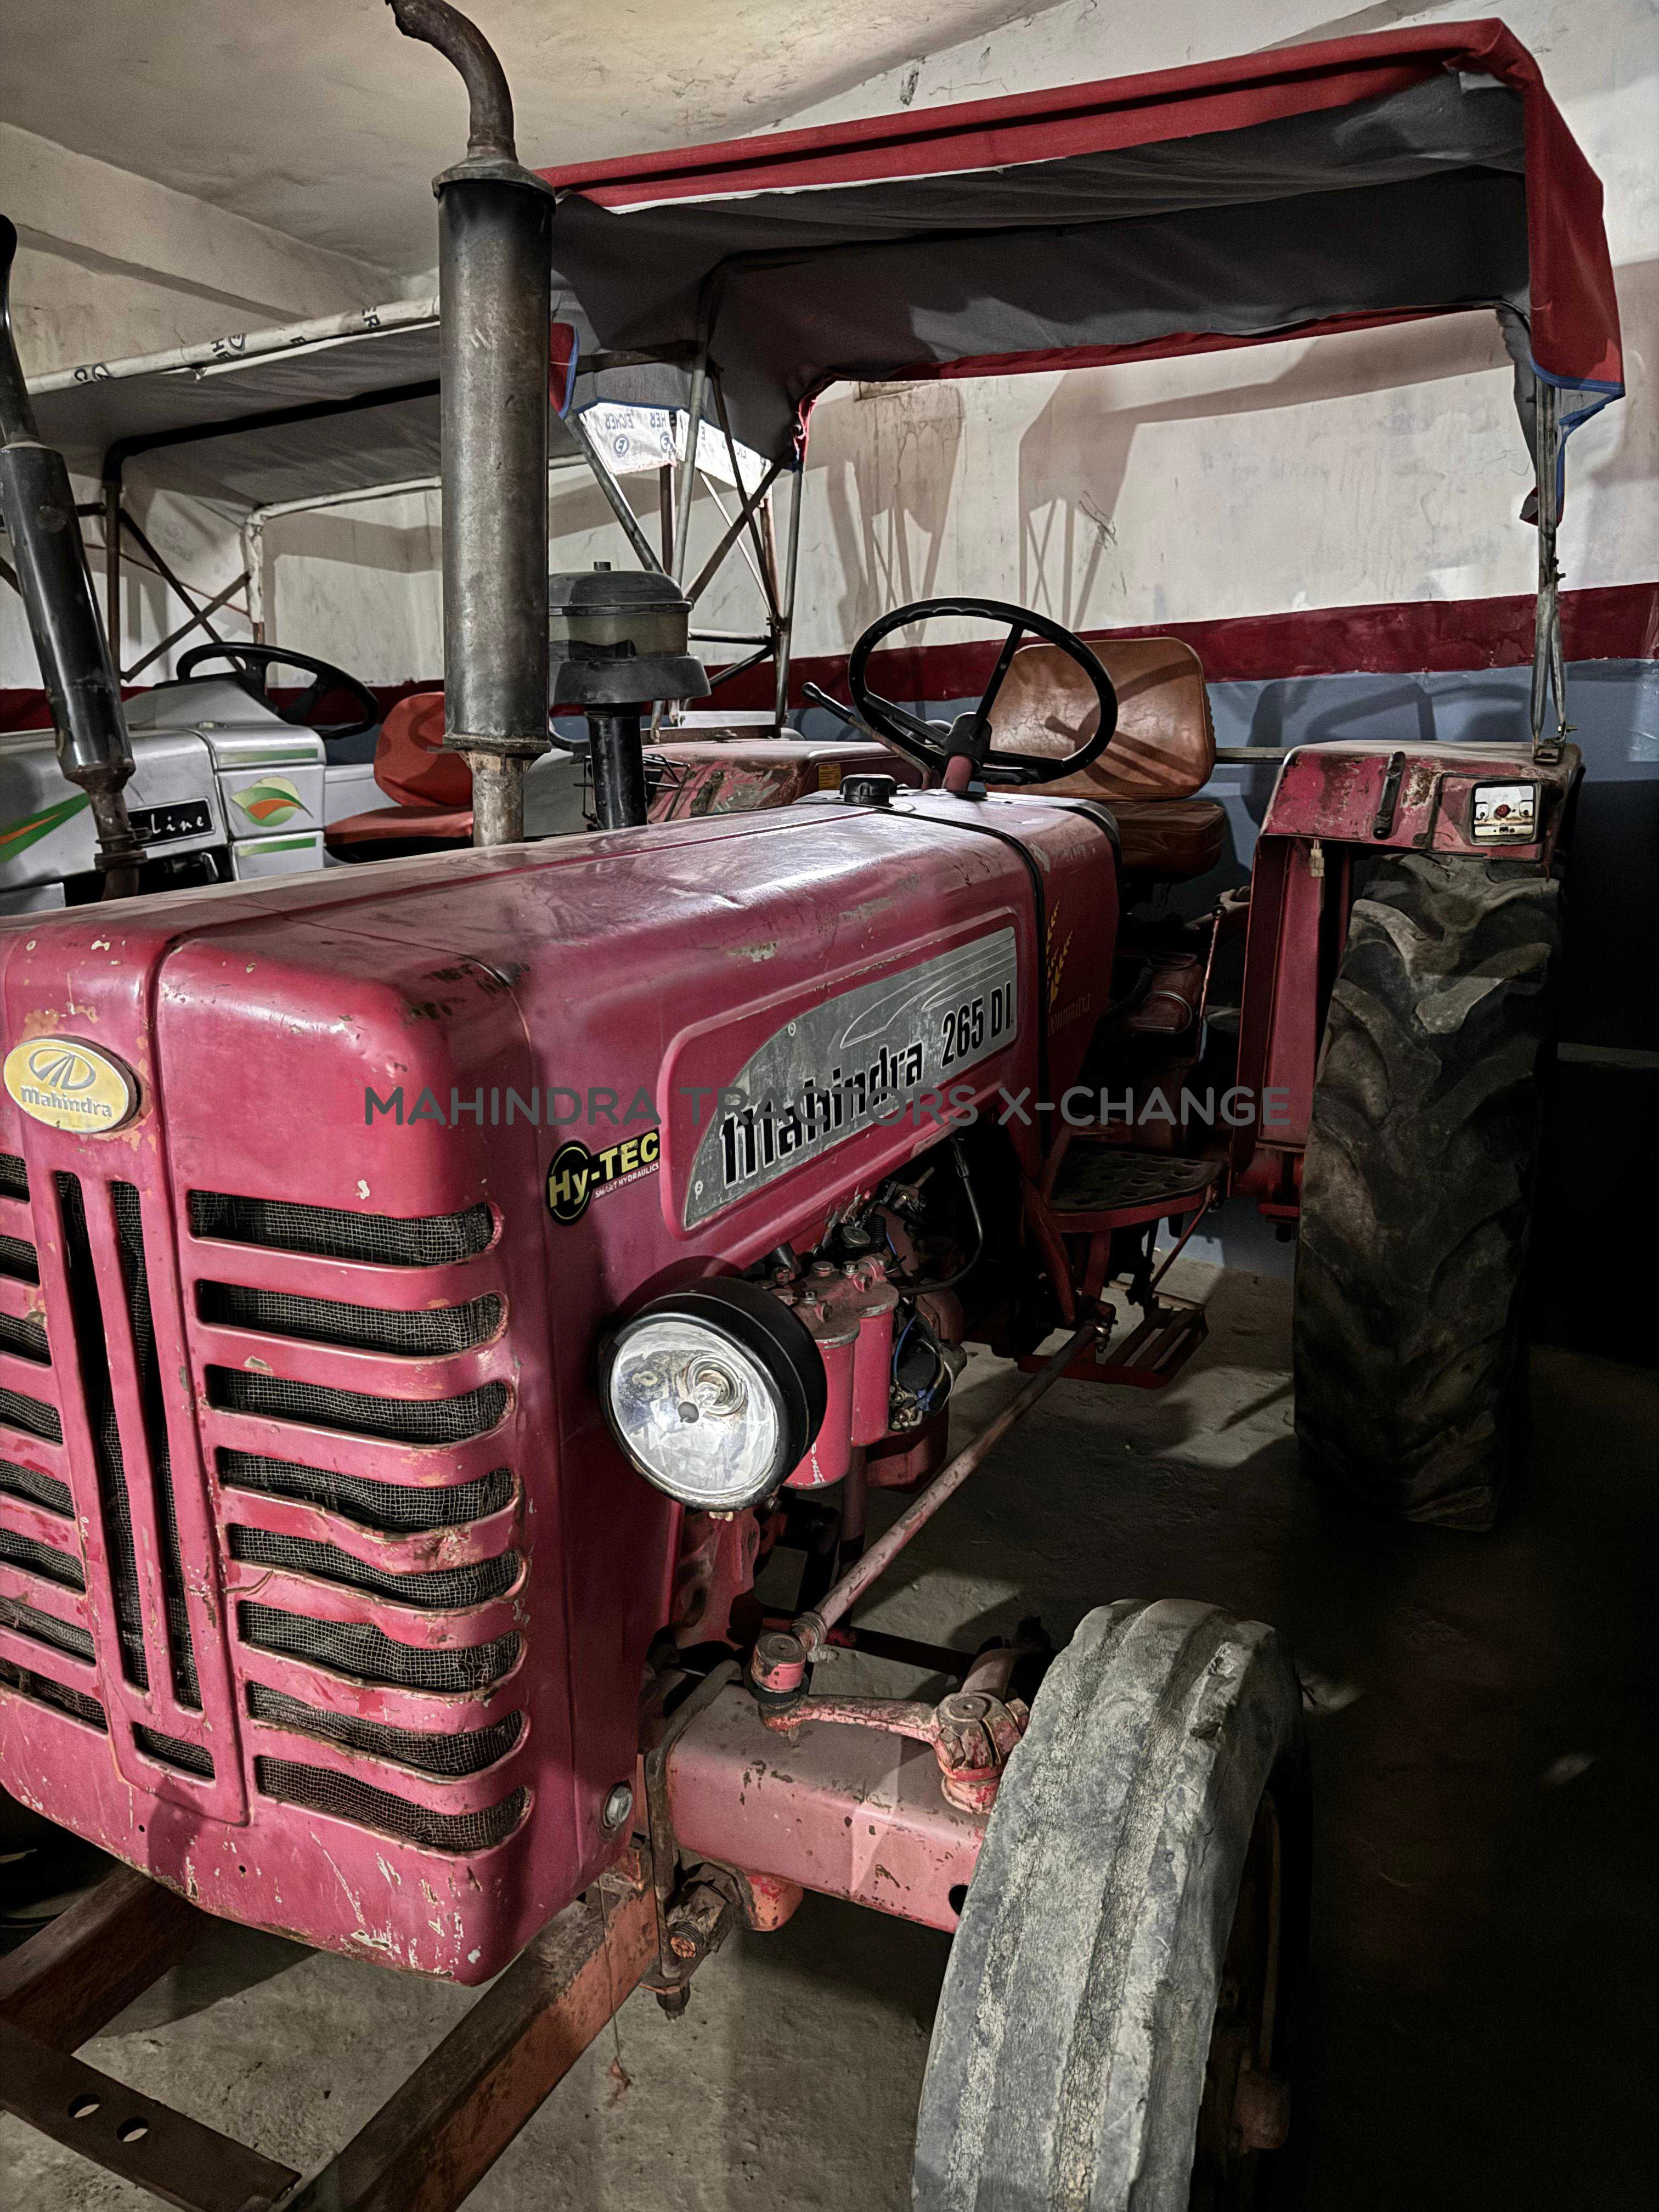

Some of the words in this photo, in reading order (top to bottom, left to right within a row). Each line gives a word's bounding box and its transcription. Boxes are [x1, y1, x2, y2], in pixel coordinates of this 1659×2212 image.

[940, 997, 984, 1069] 265
[991, 980, 1011, 1038] DI
[549, 1132, 659, 1208] Hy-TEC
[618, 1162, 659, 1187] HYDRAULICS
